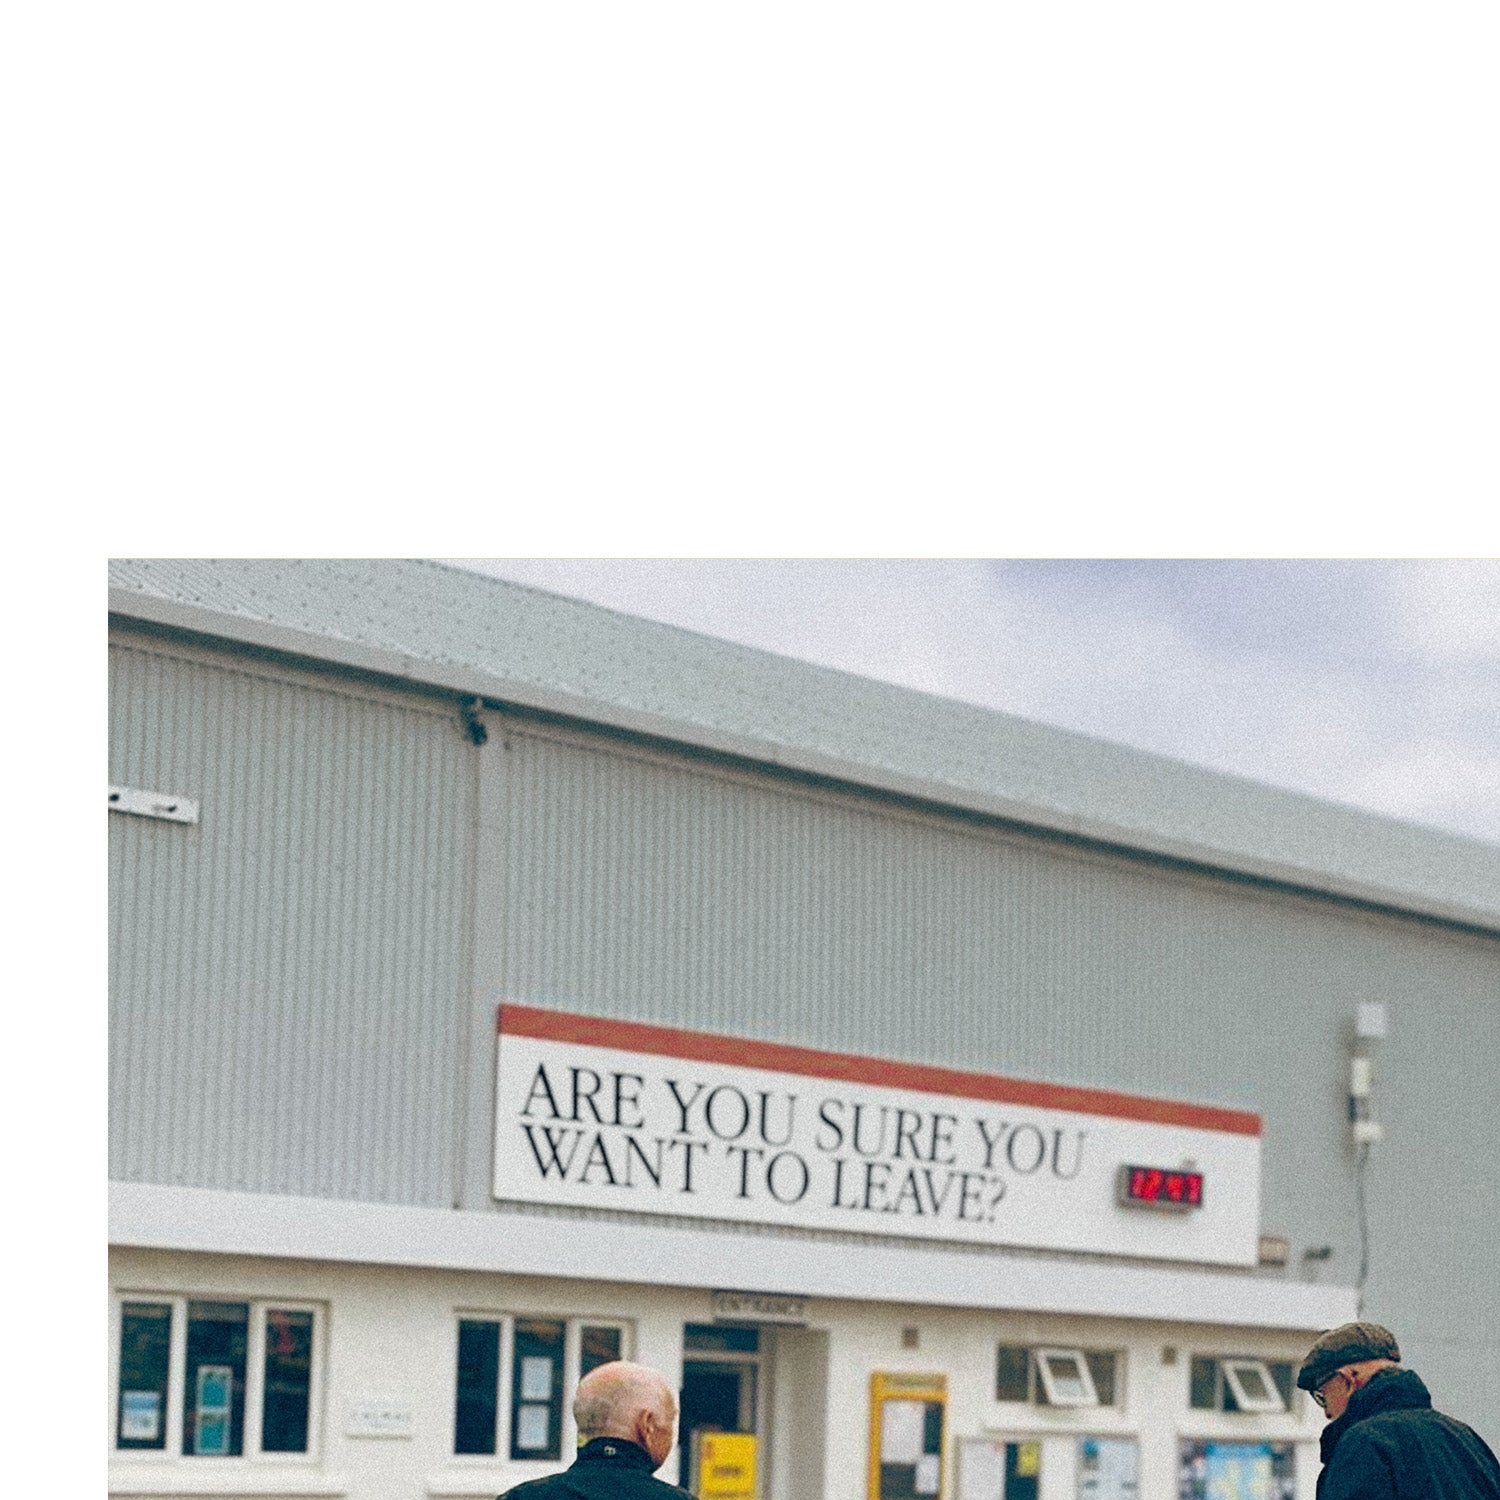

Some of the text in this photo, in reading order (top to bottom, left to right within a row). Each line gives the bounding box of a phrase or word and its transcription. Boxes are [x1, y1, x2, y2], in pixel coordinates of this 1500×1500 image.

[519, 1062, 1089, 1180] ARE YOU SURE YOU
[520, 1124, 1006, 1223] WANT TO LEAVE?
